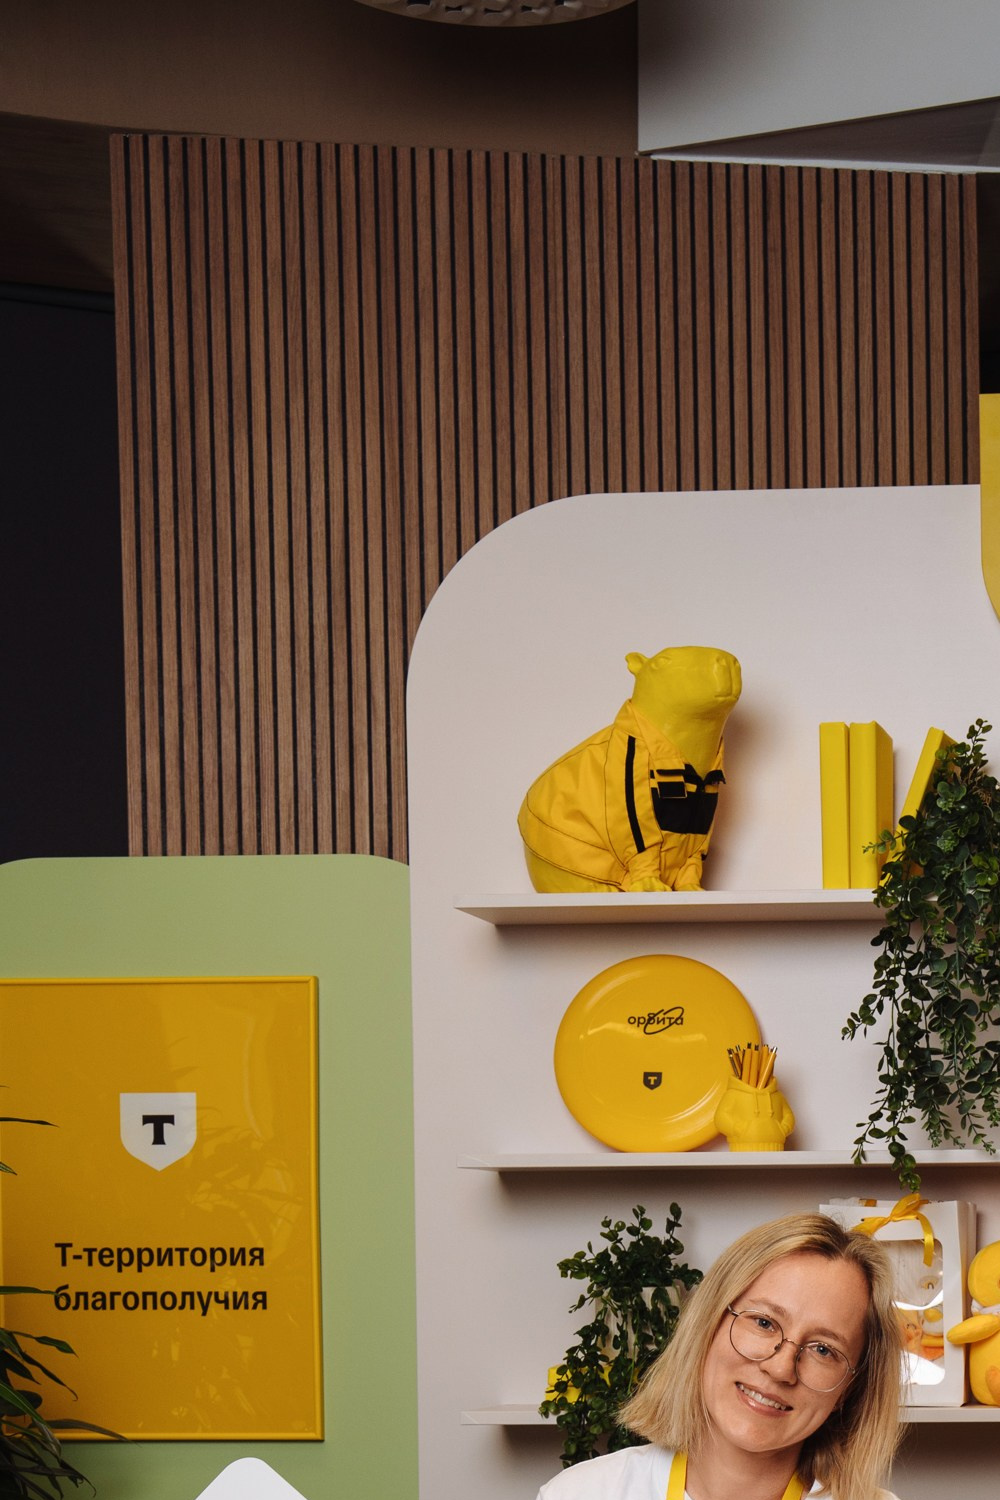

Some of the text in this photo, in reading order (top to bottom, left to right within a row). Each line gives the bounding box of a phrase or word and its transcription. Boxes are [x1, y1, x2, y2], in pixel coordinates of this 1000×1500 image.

[627, 1011, 684, 1029] орбита
[143, 1115, 175, 1146] Т
[54, 1242, 265, 1273] Т-территория
[53, 1284, 268, 1316] благополучия
